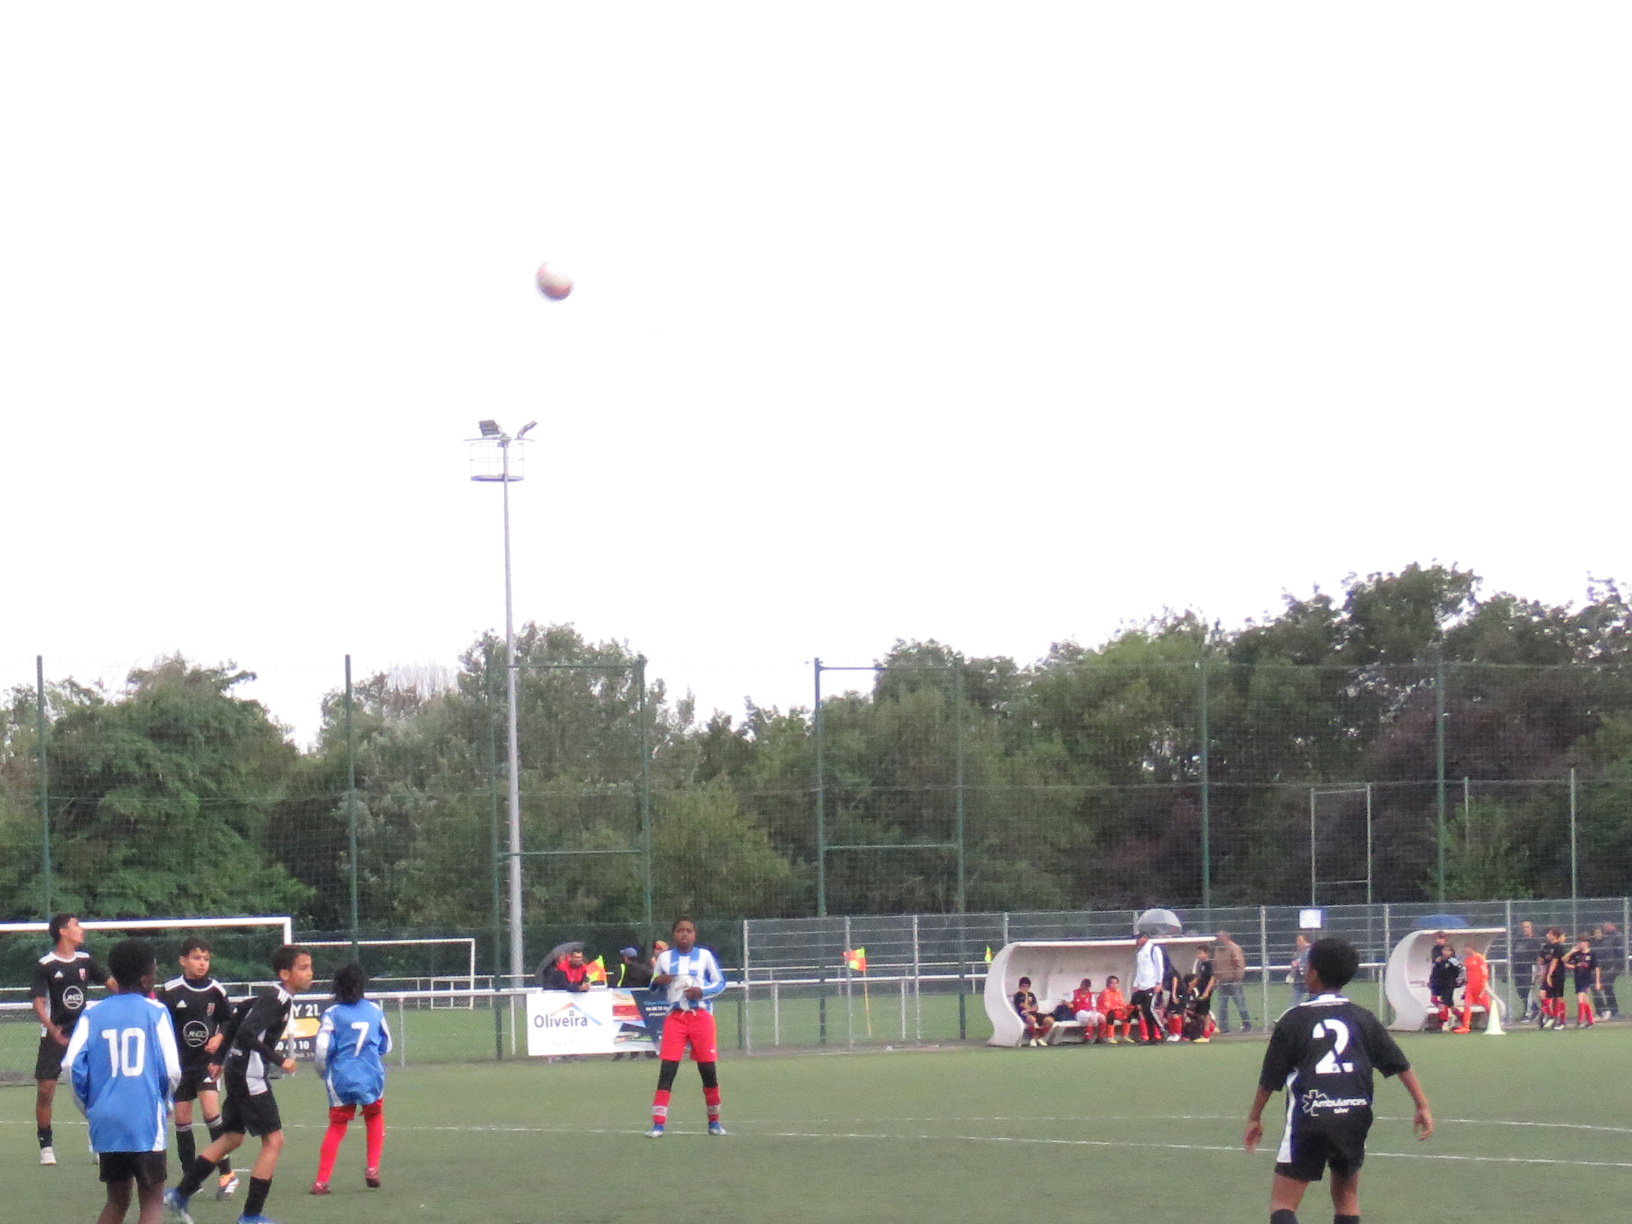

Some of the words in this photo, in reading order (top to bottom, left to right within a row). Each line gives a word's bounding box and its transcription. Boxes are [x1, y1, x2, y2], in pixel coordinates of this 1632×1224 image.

[351, 1021, 369, 1057] 7
[533, 1011, 588, 1028] Oliveira
[101, 1027, 146, 1078] 10
[1312, 1018, 1354, 1075] 2
